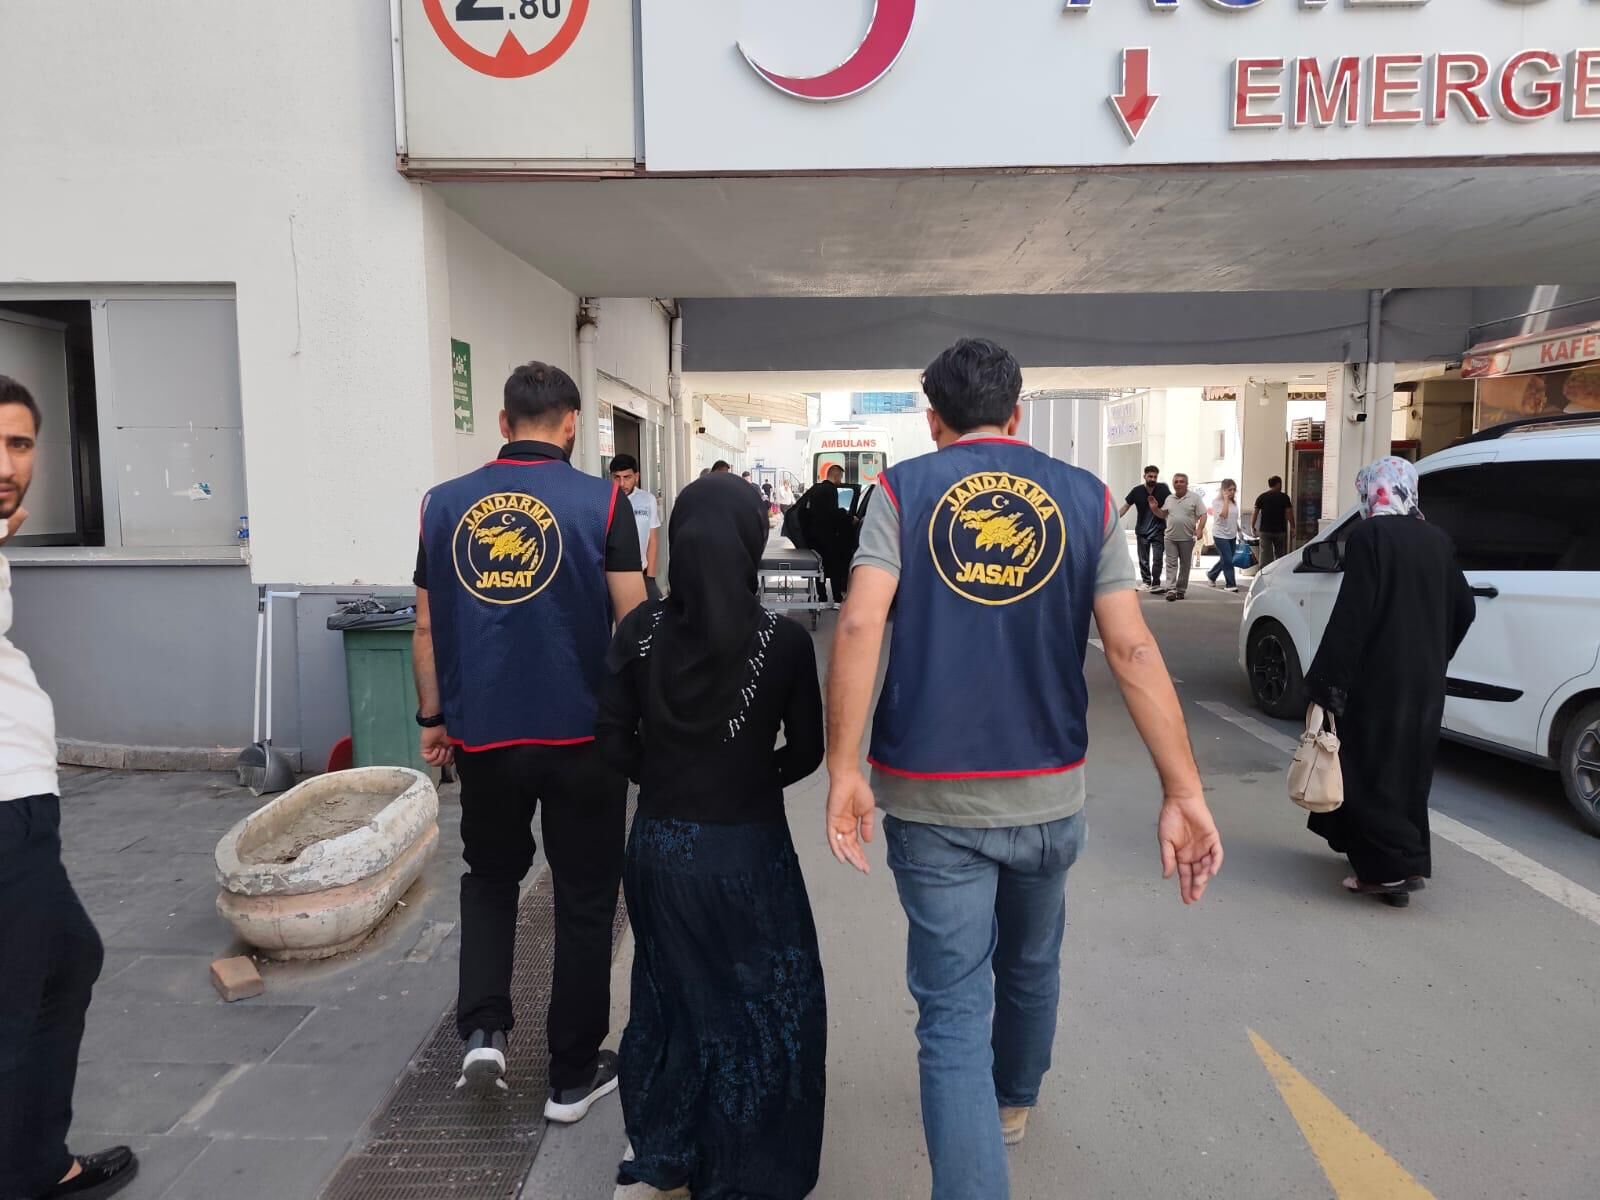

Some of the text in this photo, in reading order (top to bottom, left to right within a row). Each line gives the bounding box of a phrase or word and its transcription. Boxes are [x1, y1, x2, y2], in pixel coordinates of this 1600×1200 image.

[1231, 48, 1600, 130] EMERGE
[1541, 335, 1600, 363] KAFE
[821, 439, 877, 448] AMBULANS
[947, 476, 1057, 521] JANDARMA
[465, 495, 553, 531] JANDARMA
[476, 570, 536, 588] JASAT
[956, 562, 1030, 587] JASAT
